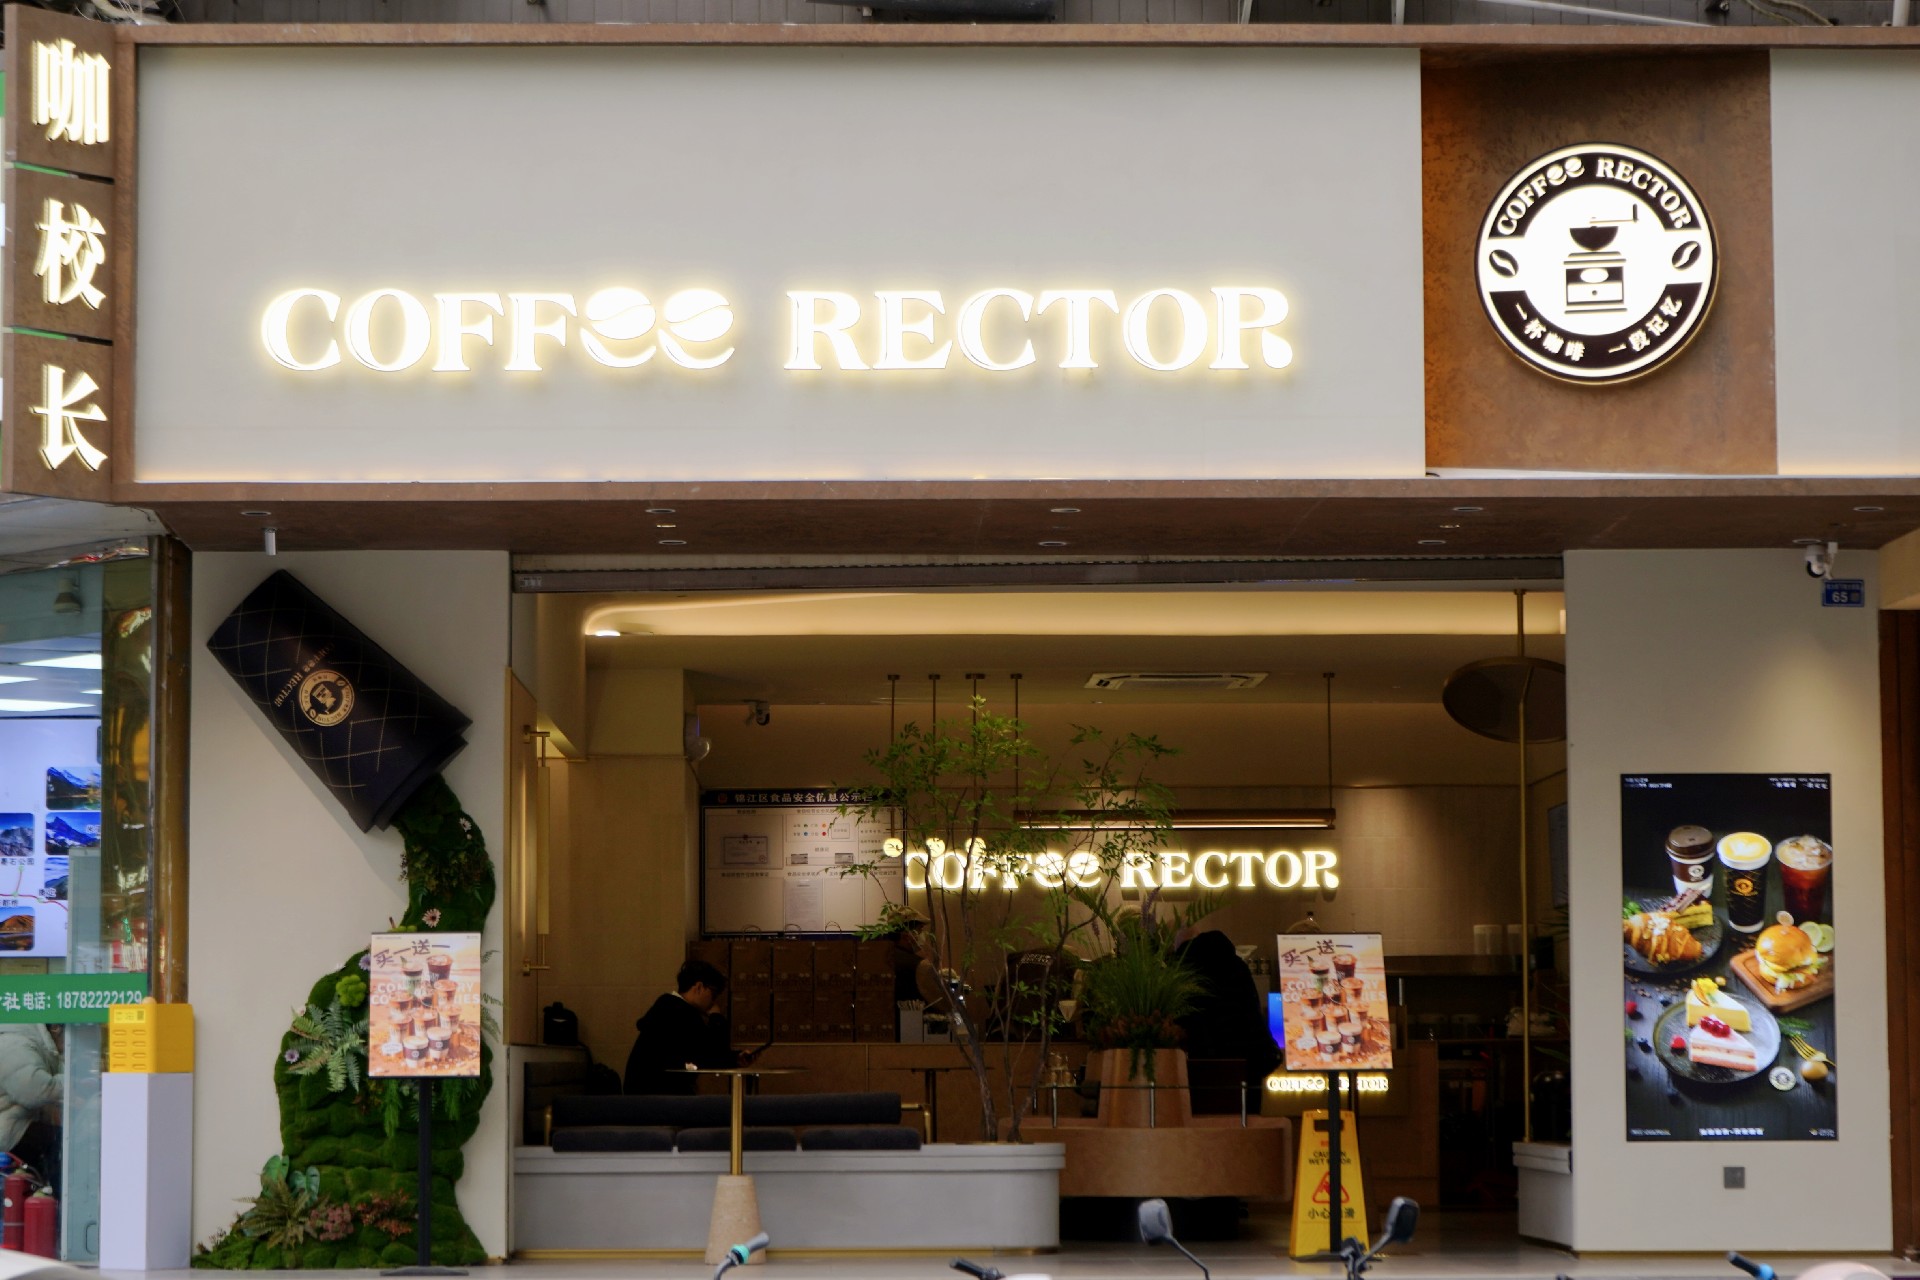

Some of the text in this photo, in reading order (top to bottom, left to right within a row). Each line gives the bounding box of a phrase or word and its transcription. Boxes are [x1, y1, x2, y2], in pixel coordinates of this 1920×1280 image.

[1596, 157, 1692, 229] RECTOR
[29, 38, 111, 471] 咖校长
[783, 287, 1293, 371] RECTOR
[1121, 850, 1341, 889] RECTOR
[374, 939, 450, 968] 买一送一
[1281, 939, 1353, 967] 买一送一
